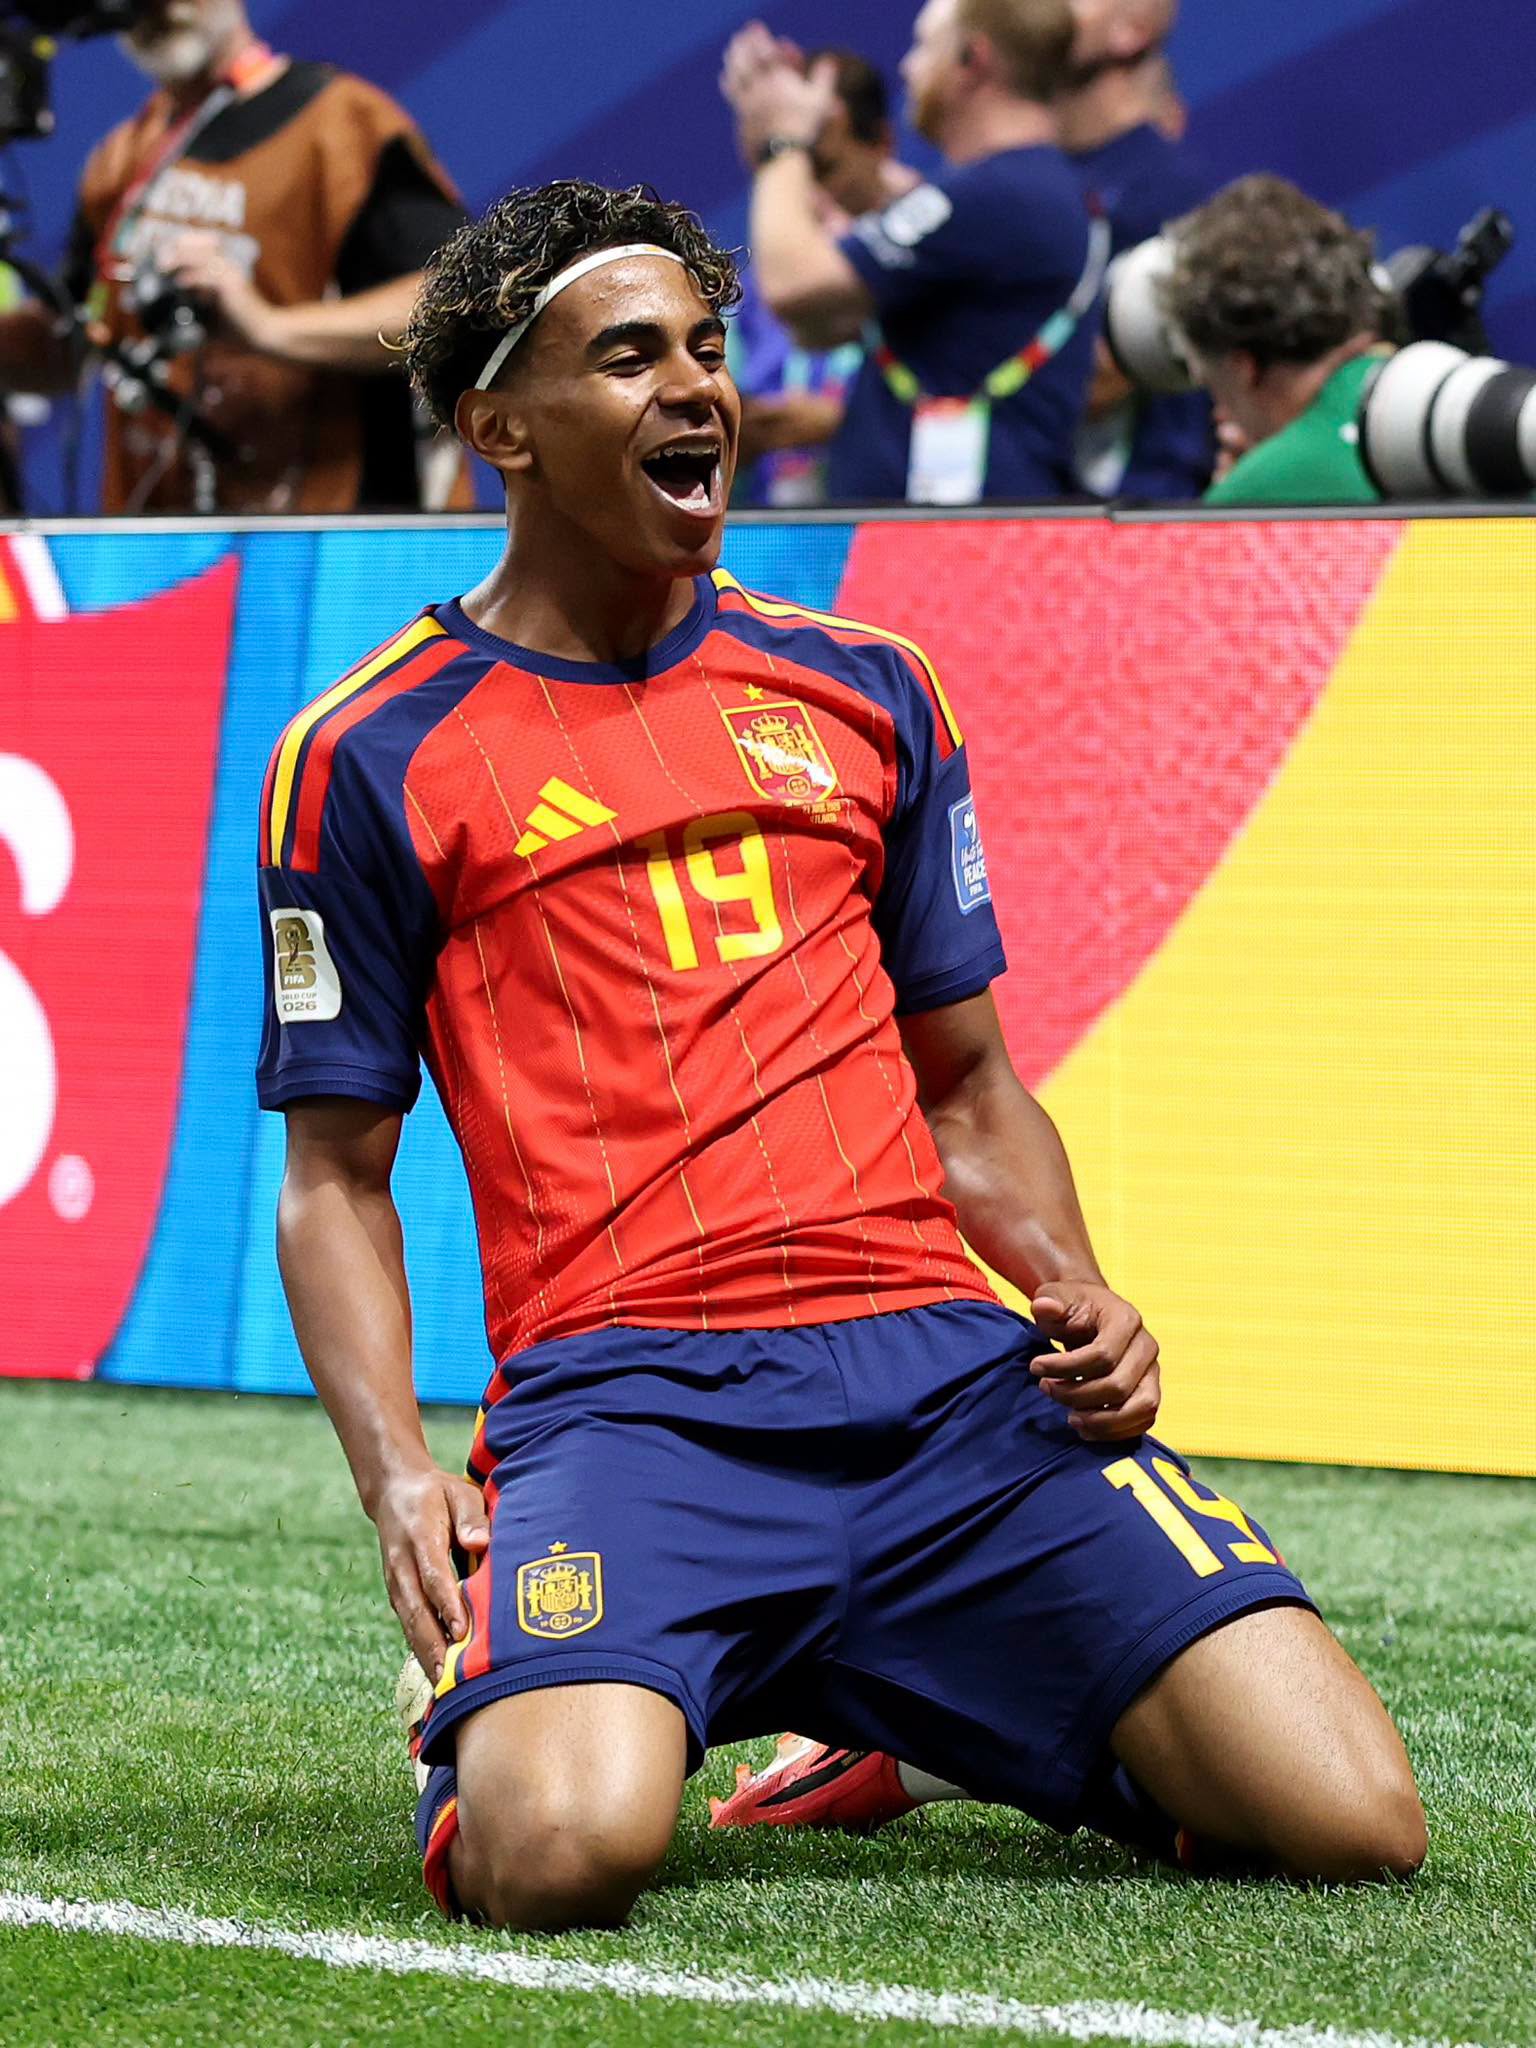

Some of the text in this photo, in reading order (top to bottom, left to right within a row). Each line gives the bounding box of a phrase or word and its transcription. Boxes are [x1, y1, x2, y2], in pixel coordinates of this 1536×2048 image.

[634, 811, 784, 972] 19
[284, 974, 305, 985] FIFA
[281, 993, 300, 1001] ORLD
[283, 1001, 318, 1013] 026
[1101, 1456, 1278, 1579] 19
